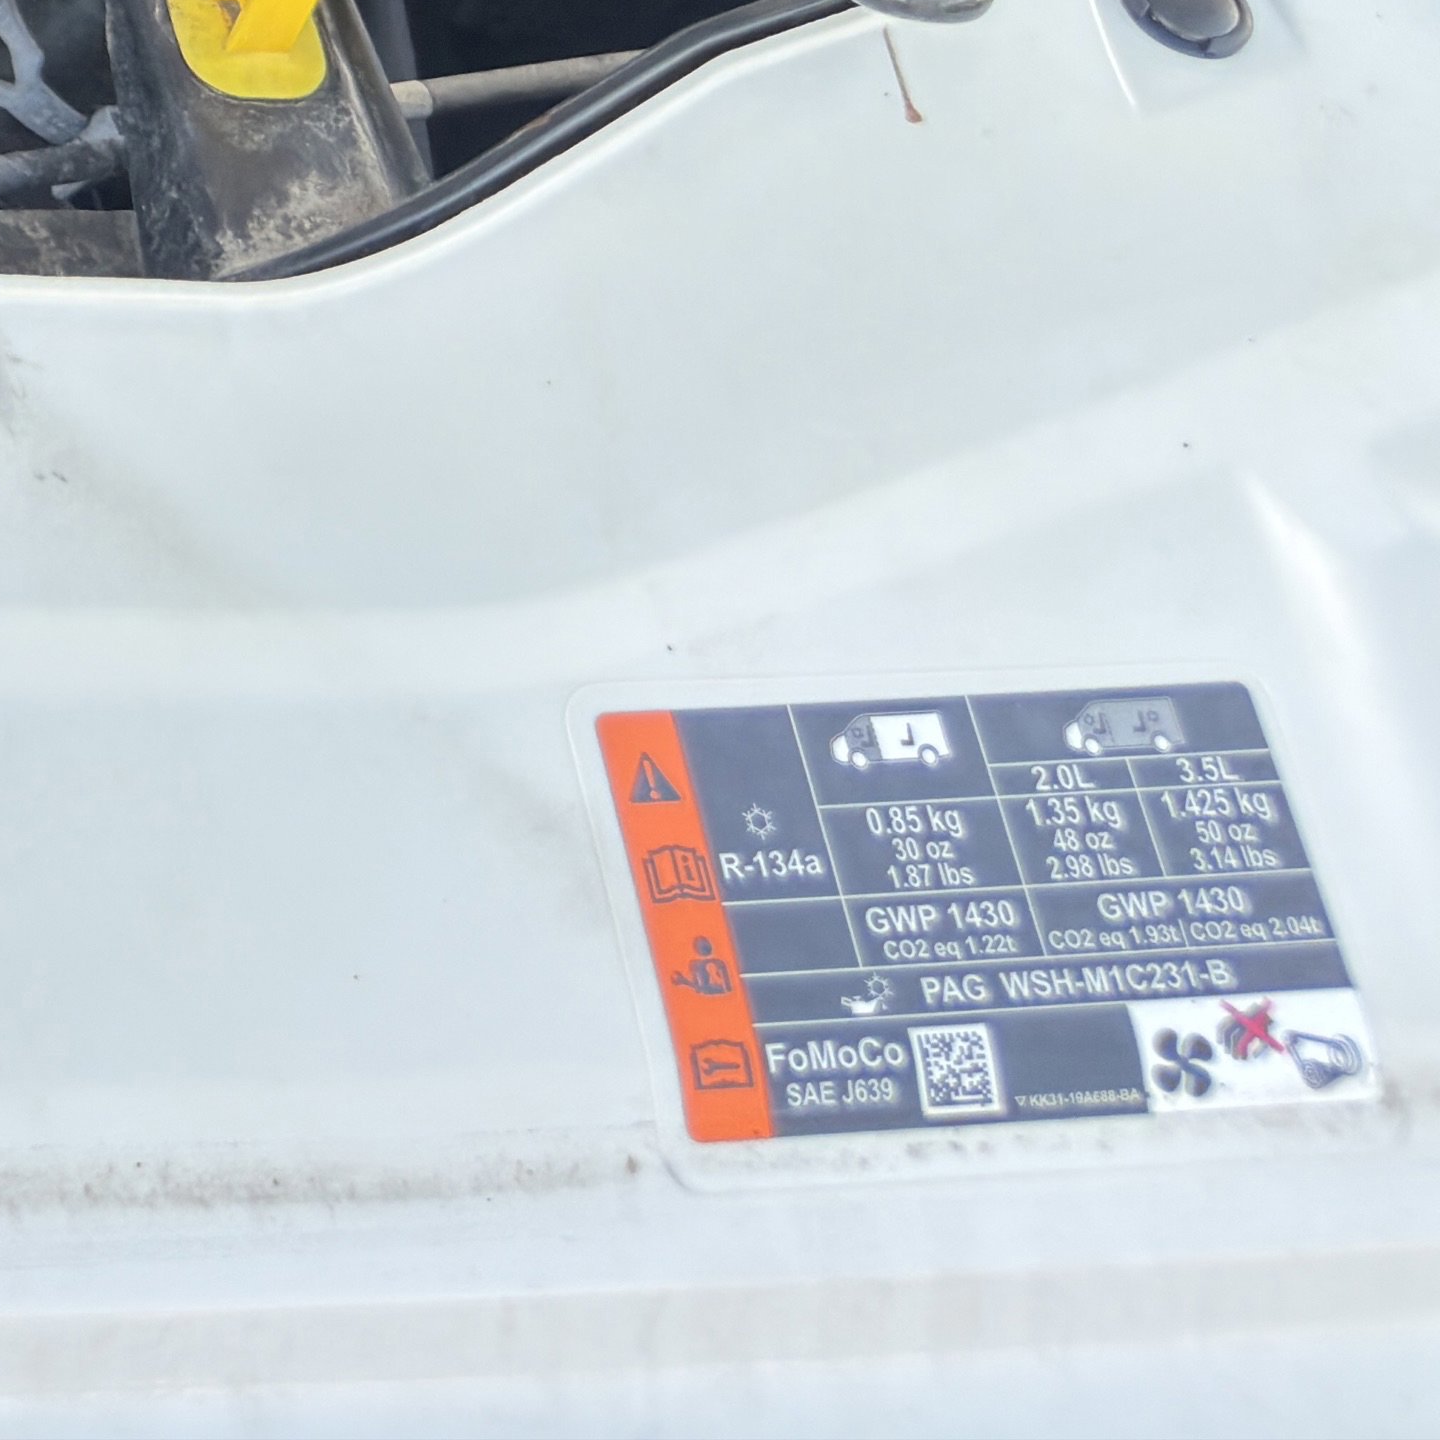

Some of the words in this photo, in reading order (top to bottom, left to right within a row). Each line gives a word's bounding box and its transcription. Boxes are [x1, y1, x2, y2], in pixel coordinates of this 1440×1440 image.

[1031, 763, 1093, 789] 2.0L
[1176, 758, 1240, 783] 3.5L
[1027, 799, 1080, 825] 1.35
[1086, 799, 1119, 829] kg
[1161, 791, 1231, 818] 1.425
[1236, 791, 1269, 822] kg
[866, 808, 922, 835] 0.85
[930, 808, 962, 839] kg
[1196, 822, 1221, 843] 50
[1227, 825, 1255, 844] oz
[892, 839, 920, 861] 30
[926, 842, 953, 861] oz
[1053, 831, 1080, 852] 48
[1085, 834, 1111, 852] oz
[719, 851, 823, 879] R-134a
[1045, 857, 1093, 879] 2.98
[1098, 853, 1133, 876] lbs
[1190, 848, 1236, 870] 3.14
[1241, 846, 1276, 868] lbs
[888, 865, 931, 888] 1.87
[937, 863, 974, 886] lbs
[1096, 892, 1168, 920] GWP
[1178, 887, 1245, 914] 1430
[864, 907, 938, 934] GWP
[948, 903, 1015, 929] 1430
[1190, 921, 1236, 942] CO2
[1239, 923, 1263, 943] eq
[1267, 917, 1320, 938] 2.04t
[882, 939, 928, 960] CO2
[935, 941, 961, 962] eq
[965, 936, 1016, 956] 1.22t
[1048, 929, 1093, 949] CO2
[1099, 931, 1126, 951] eq
[1130, 926, 1181, 946] 1.93t
[921, 976, 987, 1005] PAG
[999, 961, 1233, 998] WSH-M1C231-B
[766, 1041, 904, 1076] FoMoCo
[787, 1081, 834, 1107] SAE
[841, 1078, 893, 1103] J639
